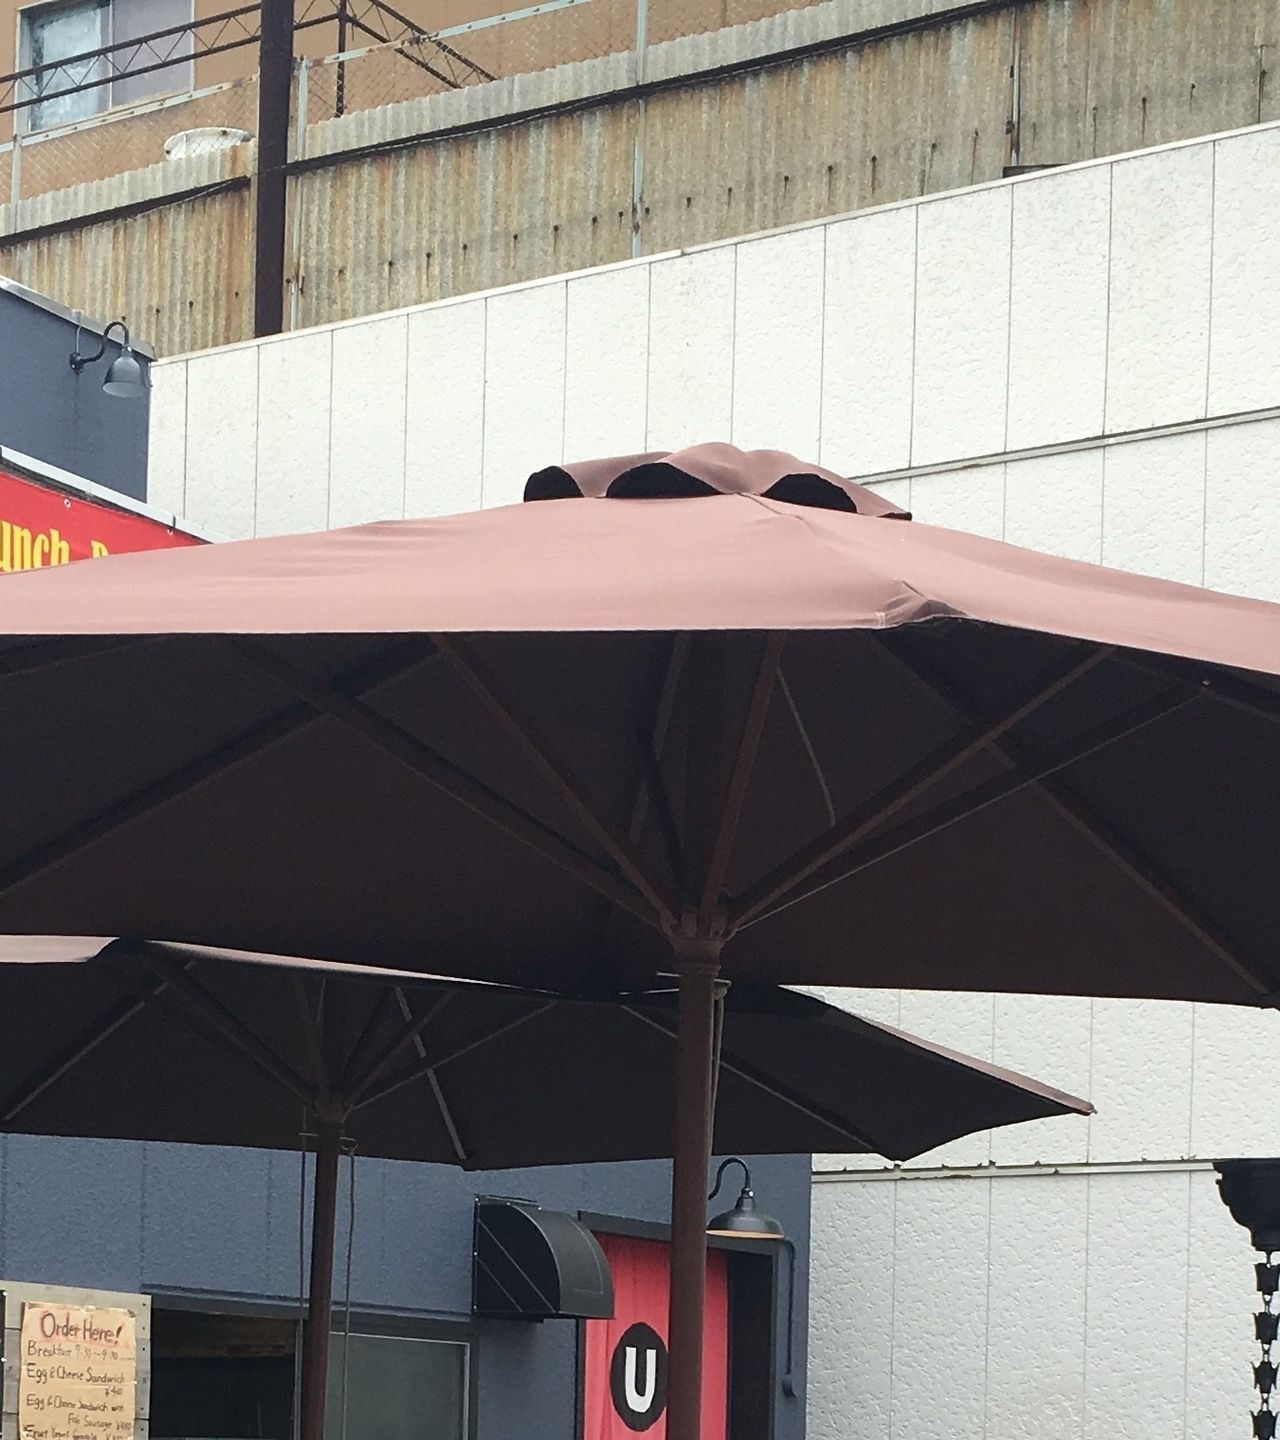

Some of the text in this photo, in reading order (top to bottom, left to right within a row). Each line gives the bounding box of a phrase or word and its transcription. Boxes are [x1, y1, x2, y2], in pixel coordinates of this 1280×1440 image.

[40, 1311, 123, 1345] Order Here!
[26, 1362, 48, 1385] Egg
[57, 1364, 84, 1381] Cheese
[86, 1366, 125, 1384] Sandwich
[625, 1347, 657, 1413] U
[26, 1393, 45, 1411] Egg
